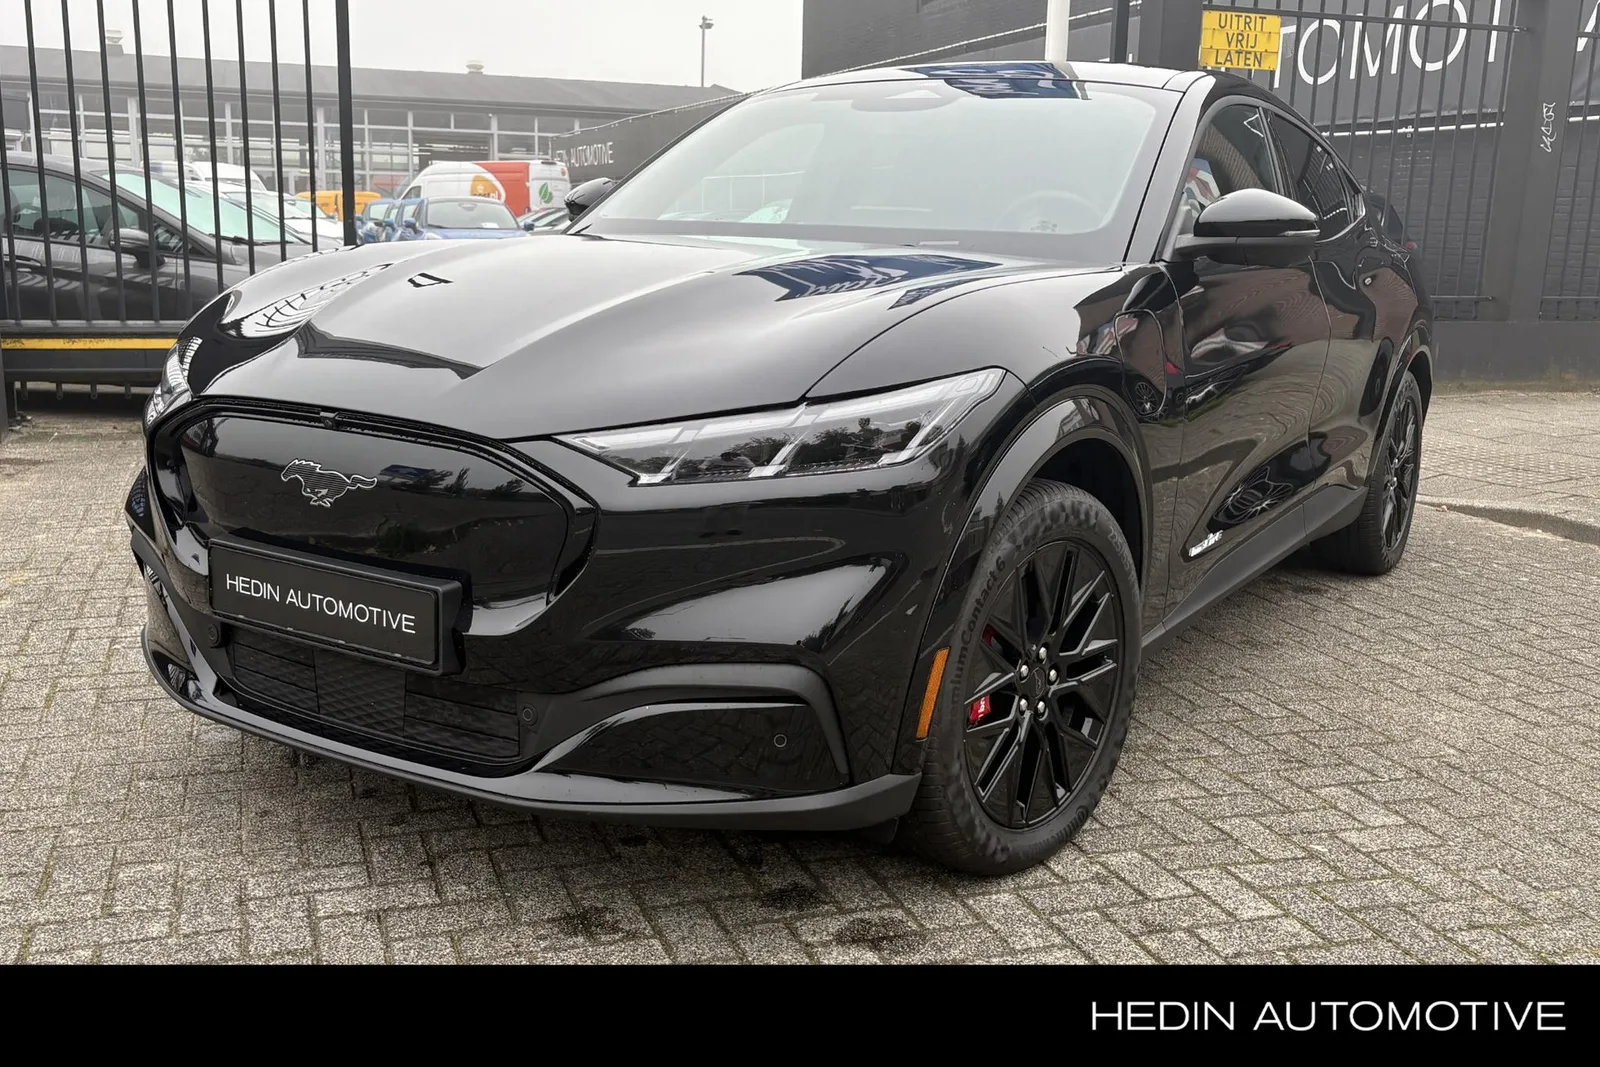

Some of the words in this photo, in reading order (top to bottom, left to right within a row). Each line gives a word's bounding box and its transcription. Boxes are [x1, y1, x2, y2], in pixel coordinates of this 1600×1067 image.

[1218, 13, 1267, 32] UITRIT
[1226, 31, 1258, 49] VRIJ
[1214, 49, 1263, 68] LATEN
[226, 573, 280, 602] HEDIN
[285, 588, 417, 634] AUTOMOTIVE
